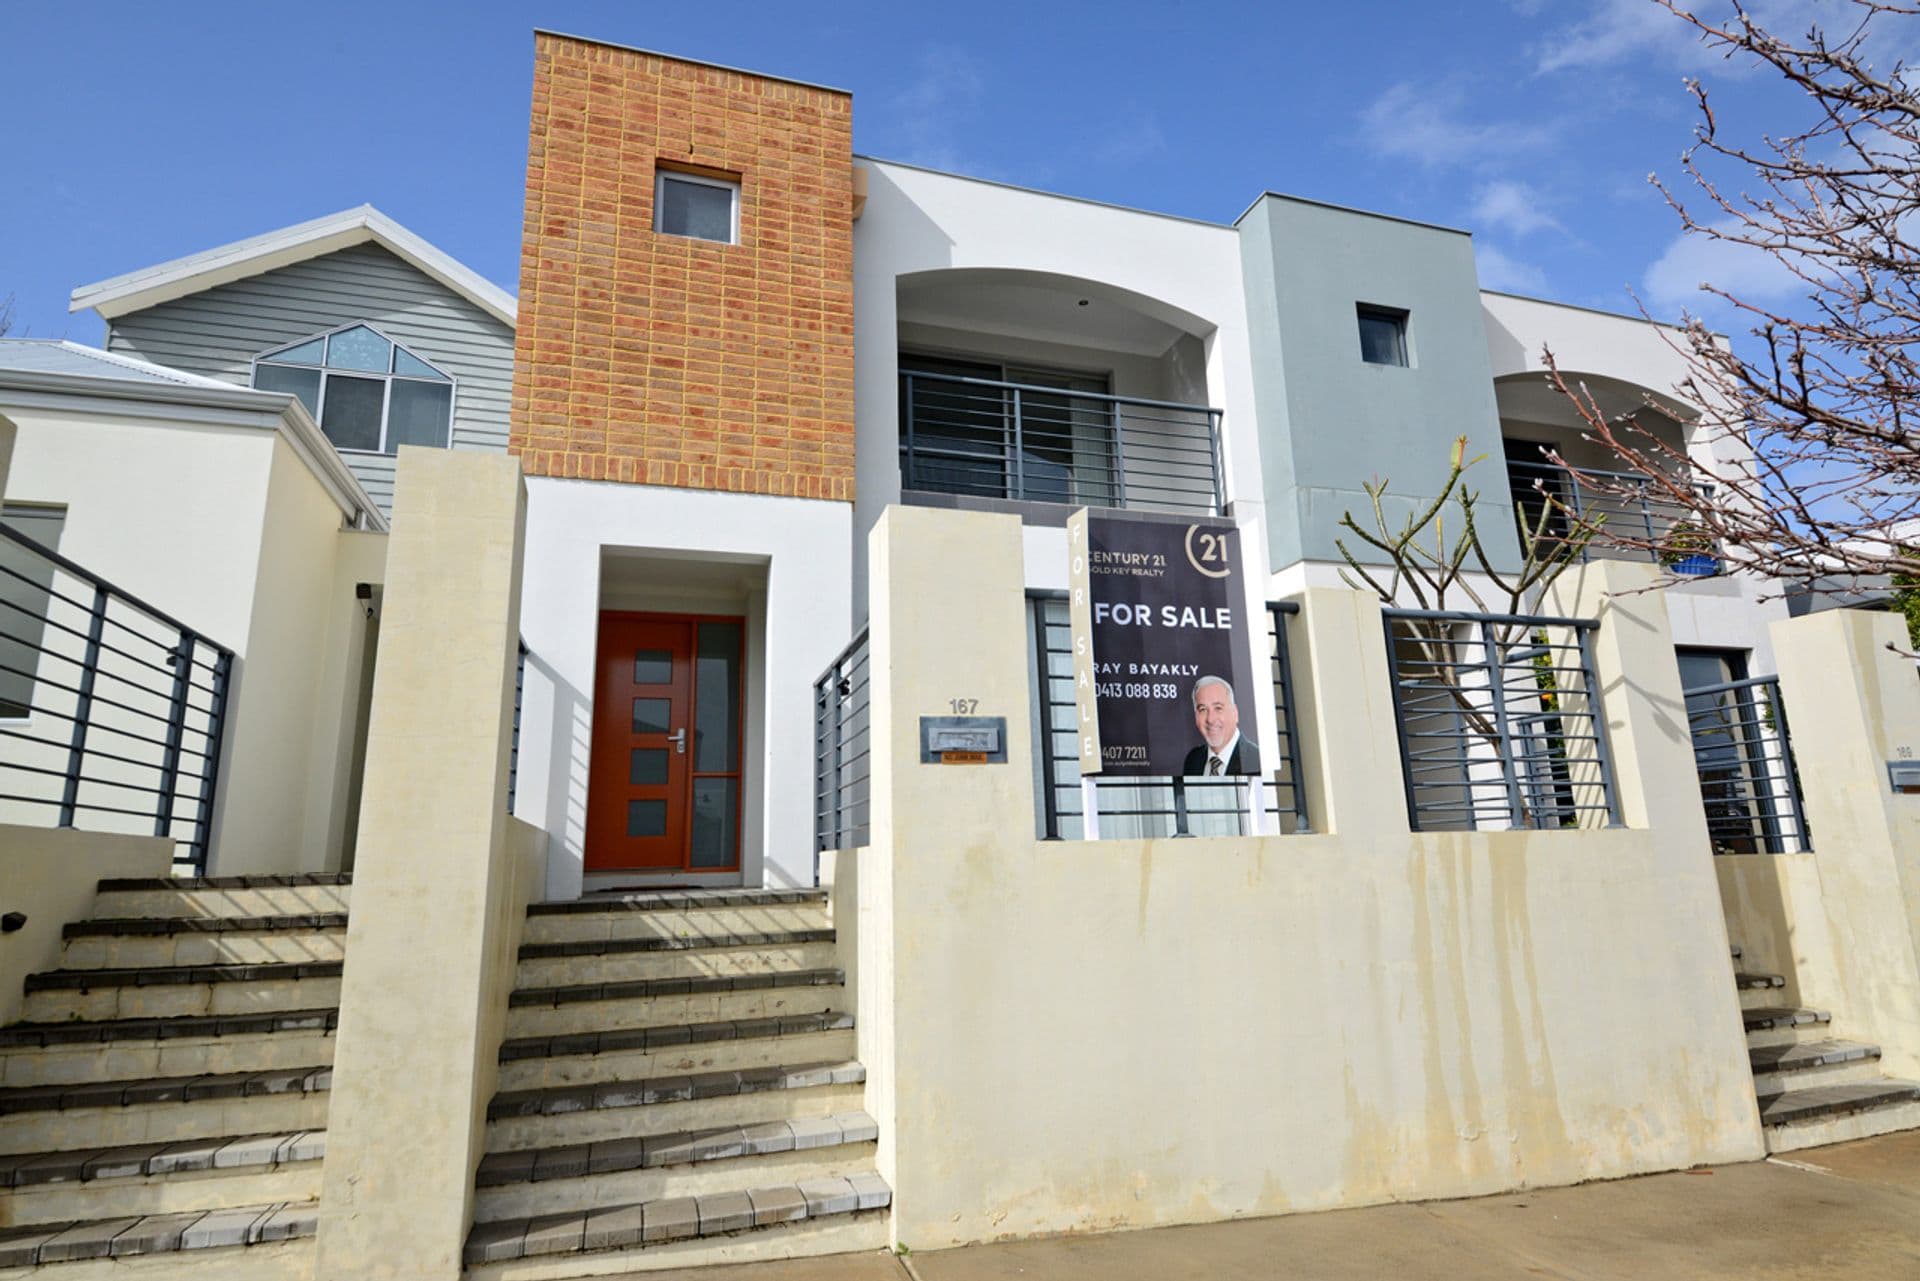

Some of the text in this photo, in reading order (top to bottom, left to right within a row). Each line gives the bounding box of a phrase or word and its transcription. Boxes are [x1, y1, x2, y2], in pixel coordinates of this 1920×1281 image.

[1152, 554, 1167, 567] 21
[1090, 566, 1165, 577] OLD KEY REALTY
[1095, 602, 1232, 630] FOR SALE
[1093, 662, 1199, 677] RAY BAYAKLY
[1076, 636, 1093, 758] SALE
[1095, 682, 1177, 699] 0413 088 838
[949, 698, 979, 715] 167
[1124, 746, 1146, 760] 7211
